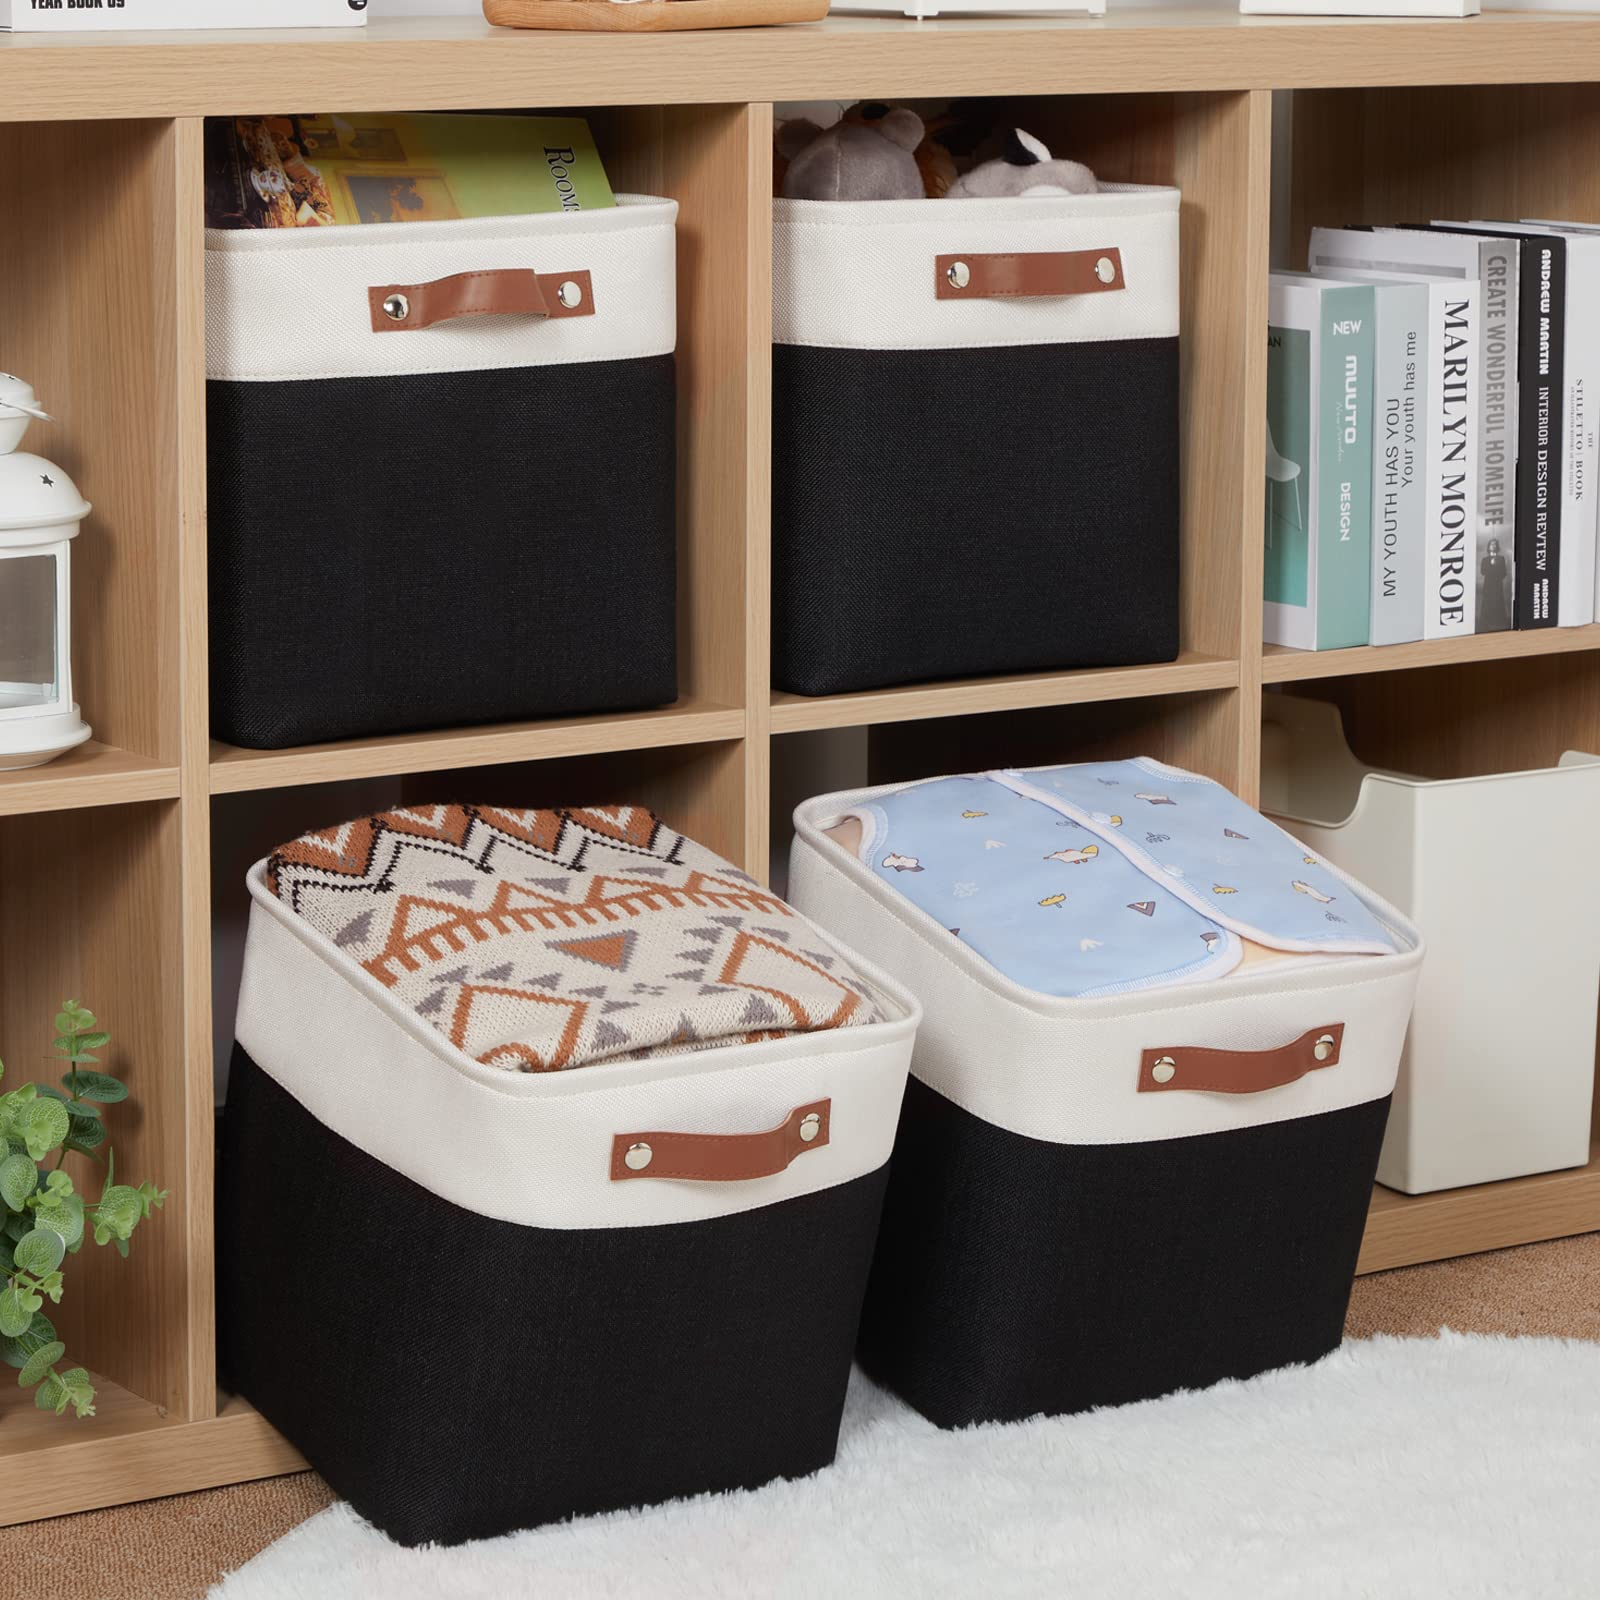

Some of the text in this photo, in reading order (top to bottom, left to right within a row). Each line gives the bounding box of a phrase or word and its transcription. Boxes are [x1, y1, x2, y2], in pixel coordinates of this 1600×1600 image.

[1333, 320, 1362, 336] NEW
[1539, 249, 1551, 375] ANDREW MARTIN
[1401, 331, 1417, 488] Your youth has me
[1485, 255, 1507, 526] CREATE WONDERFUL HOMELIFE
[1538, 386, 1549, 446] INTERIOR
[1575, 378, 1584, 500] STILETTO BOOK
[1340, 482, 1351, 542] DESIGN
[1383, 398, 1400, 597] MY YOUTH HAS YOU
[1439, 299, 1469, 626] MARILYN MONROE
[1536, 450, 1548, 508] DESIGN
[1533, 583, 1541, 619] MARTIN
